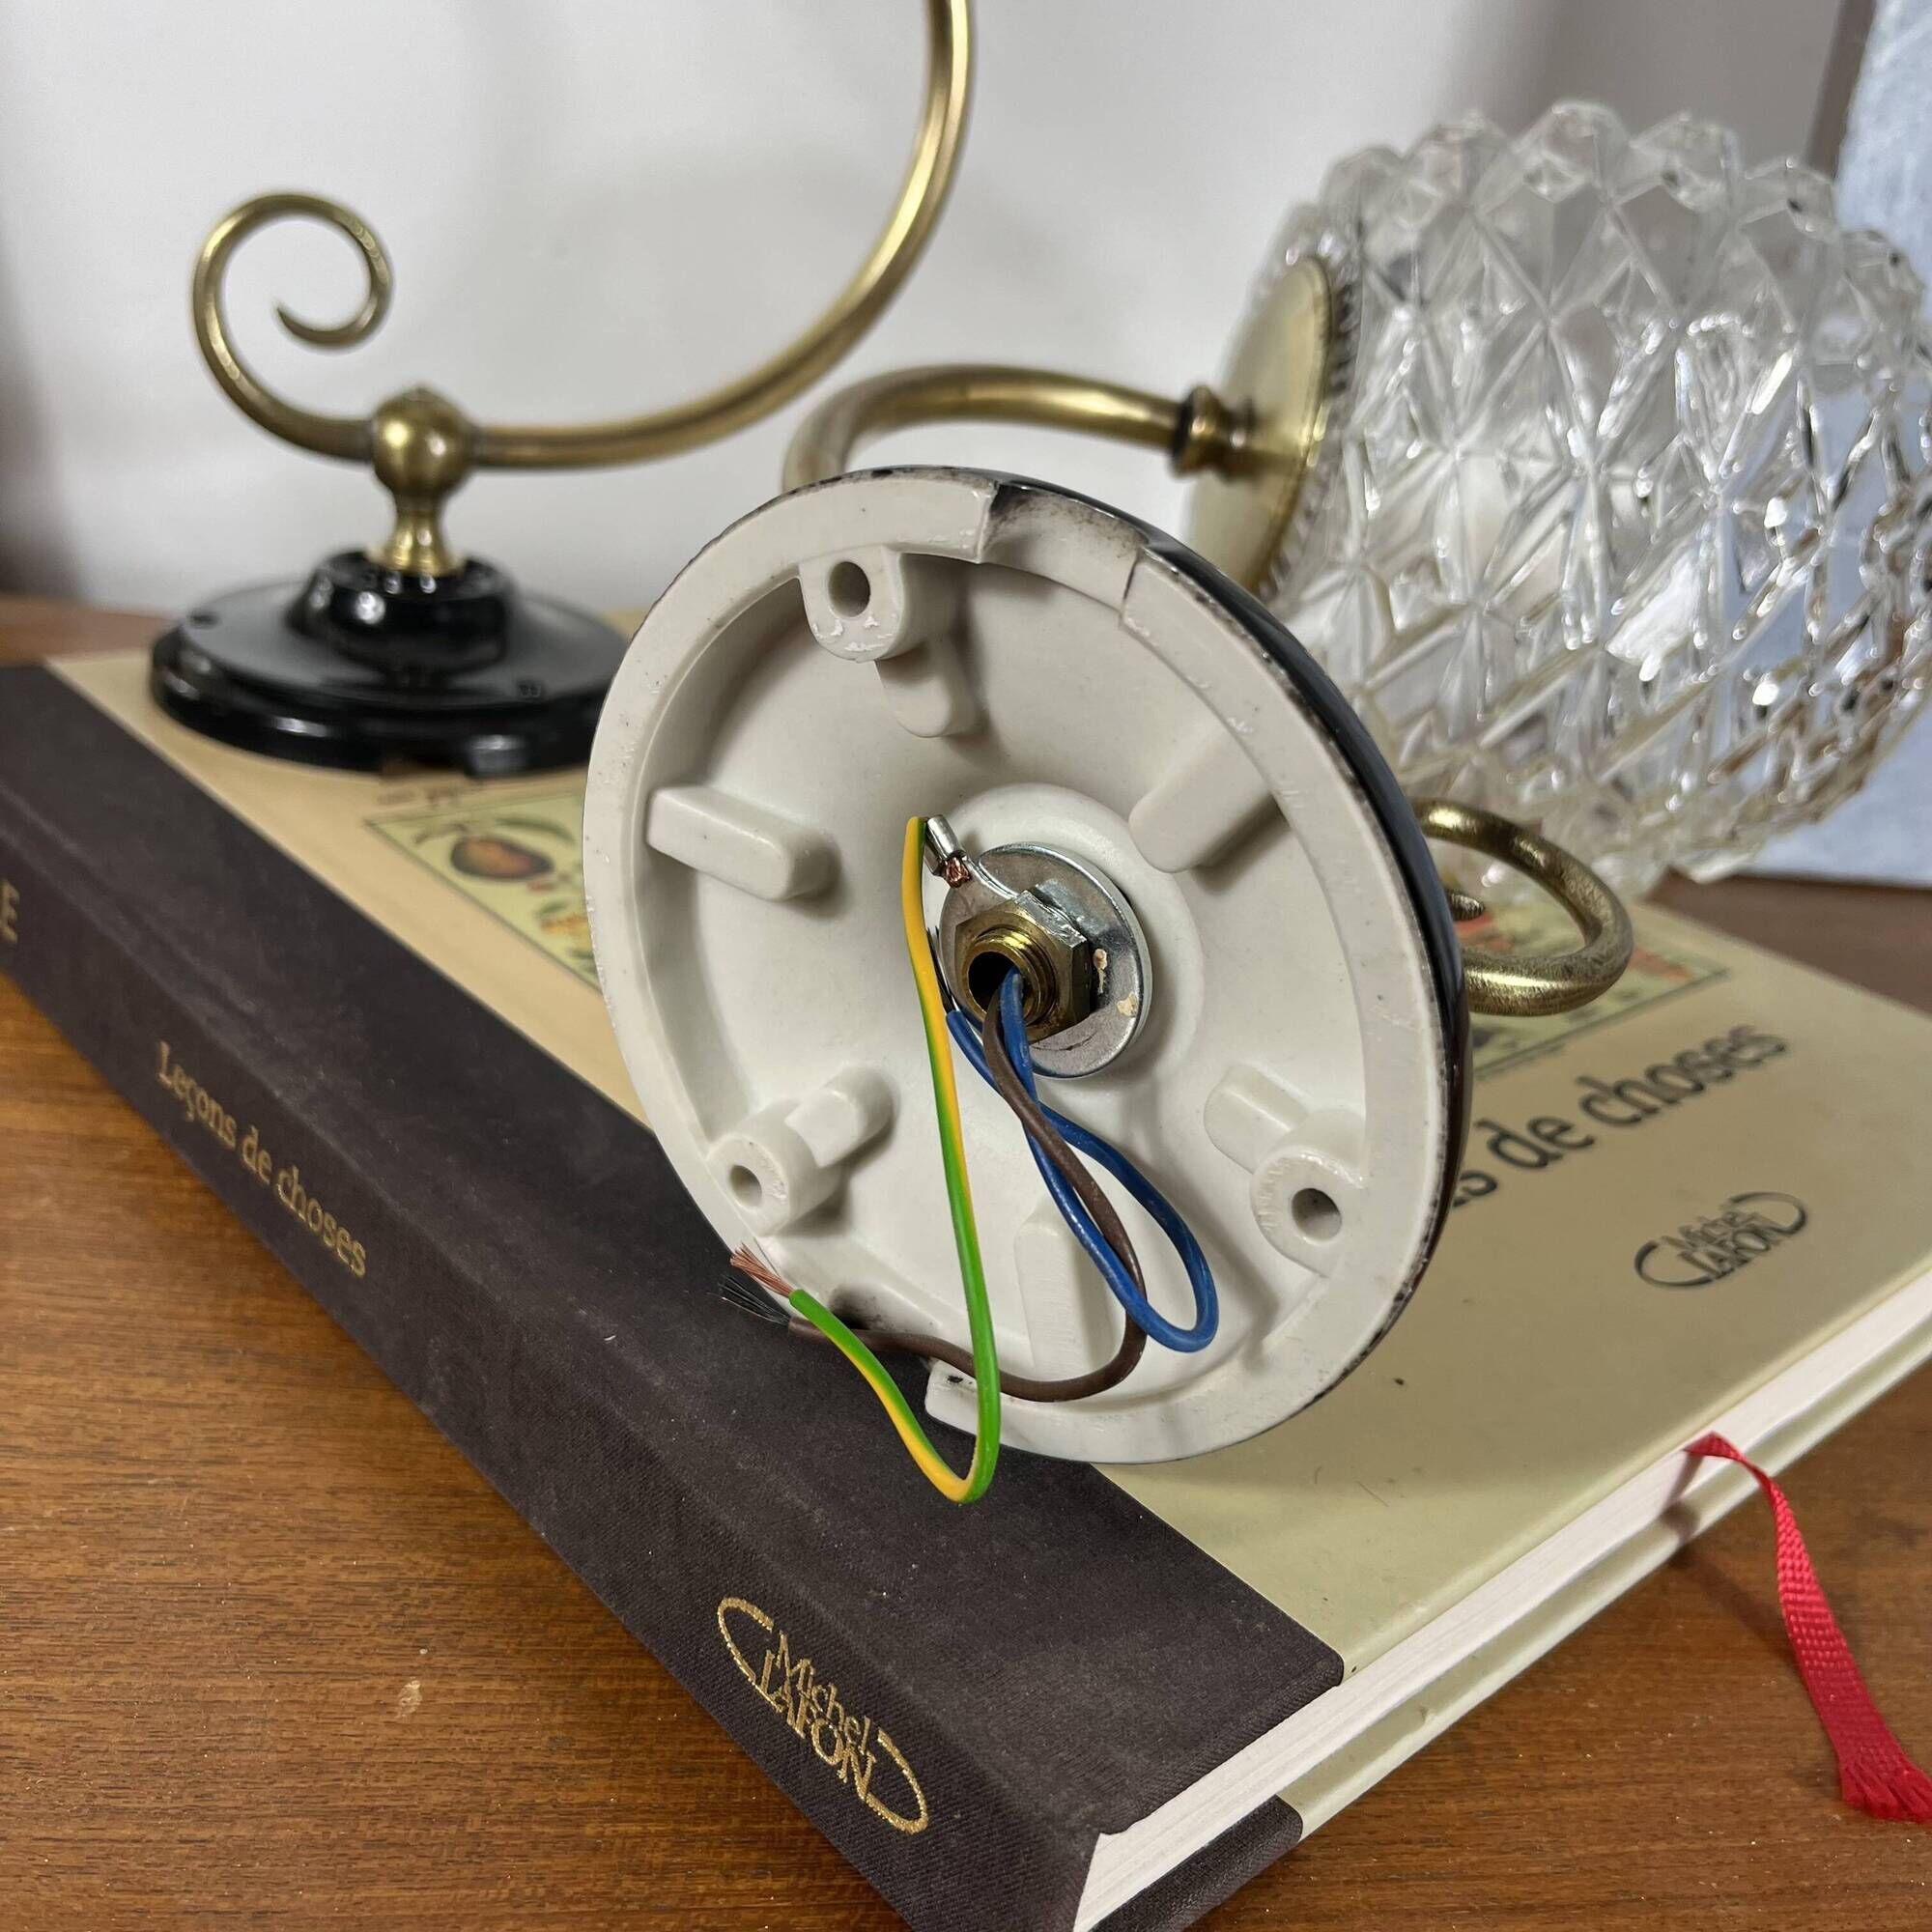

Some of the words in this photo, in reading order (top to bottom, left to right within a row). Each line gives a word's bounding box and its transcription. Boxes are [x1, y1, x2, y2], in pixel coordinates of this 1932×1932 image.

[156, 1040, 238, 1150] Leçons
[242, 1124, 272, 1185] de
[275, 1164, 366, 1277] choses
[1473, 1117, 1596, 1170] de
[1575, 1025, 1786, 1127] choses
[776, 1629, 871, 1756] Michel
